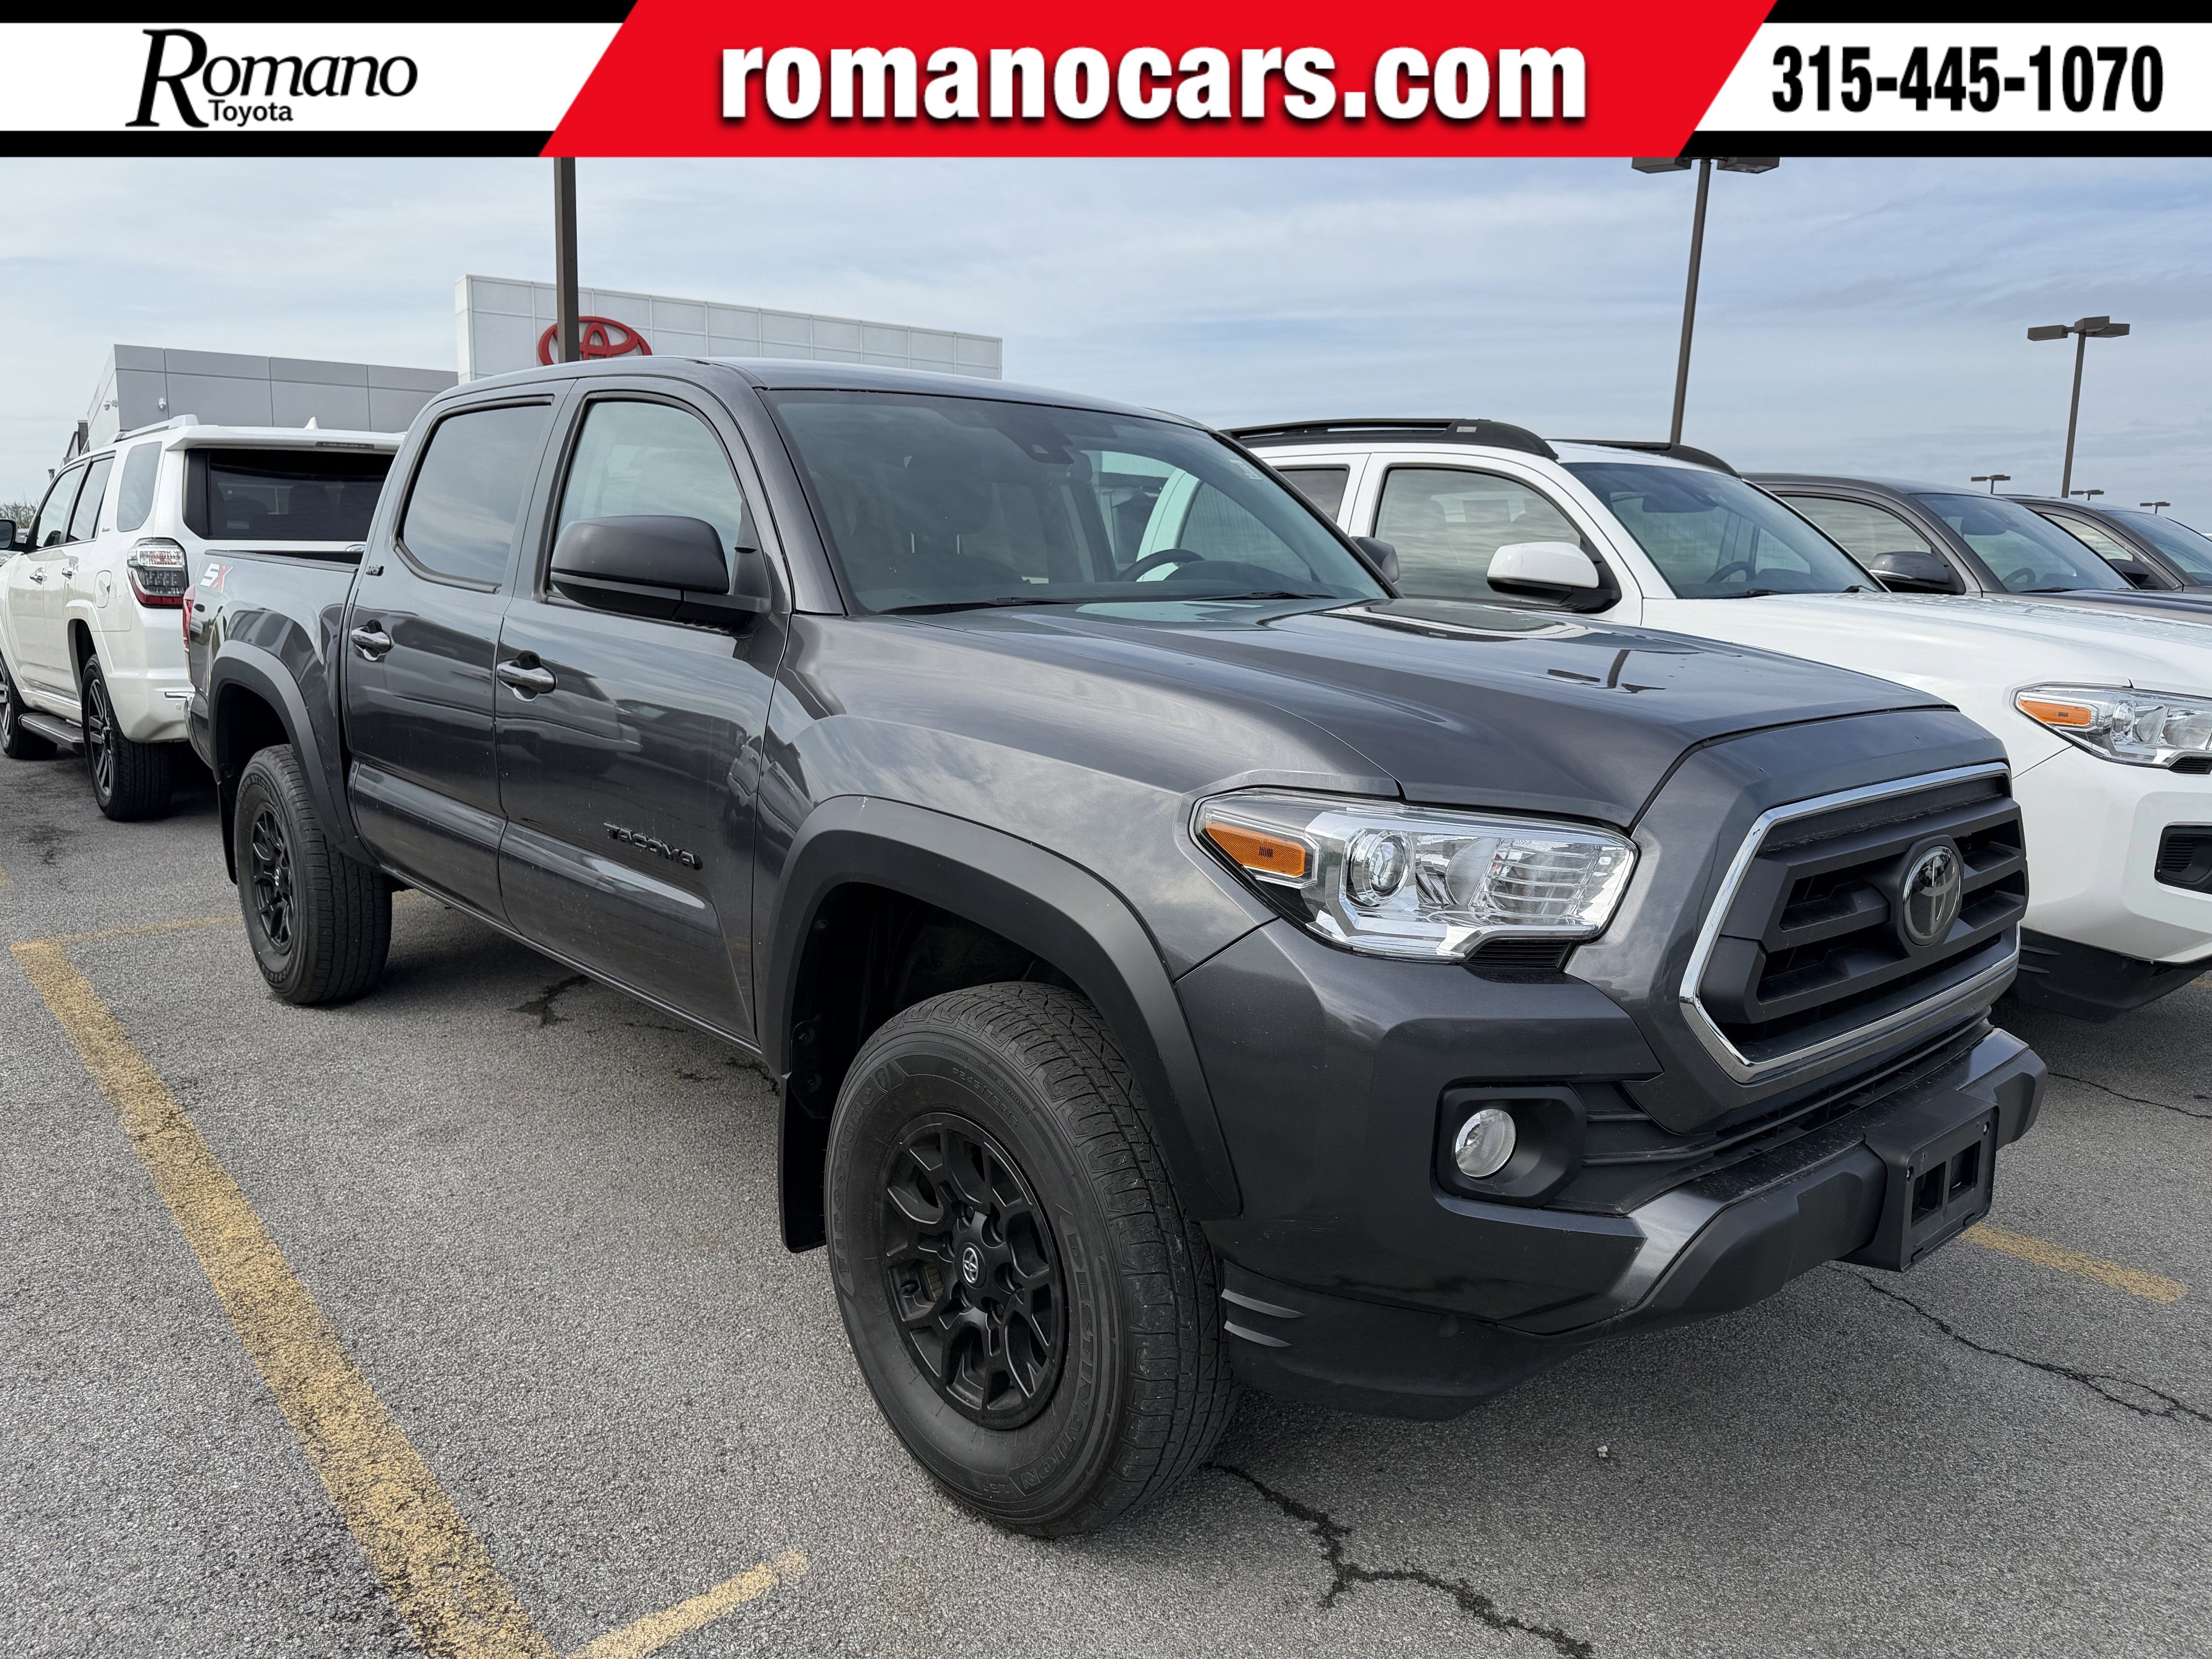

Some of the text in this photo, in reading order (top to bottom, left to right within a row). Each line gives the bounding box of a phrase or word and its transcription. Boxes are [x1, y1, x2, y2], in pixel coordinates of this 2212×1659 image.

[603, 821, 704, 871] TACOMA
[833, 1087, 874, 1278] Firestone
[1020, 1232, 1097, 1490] DESTINATION
